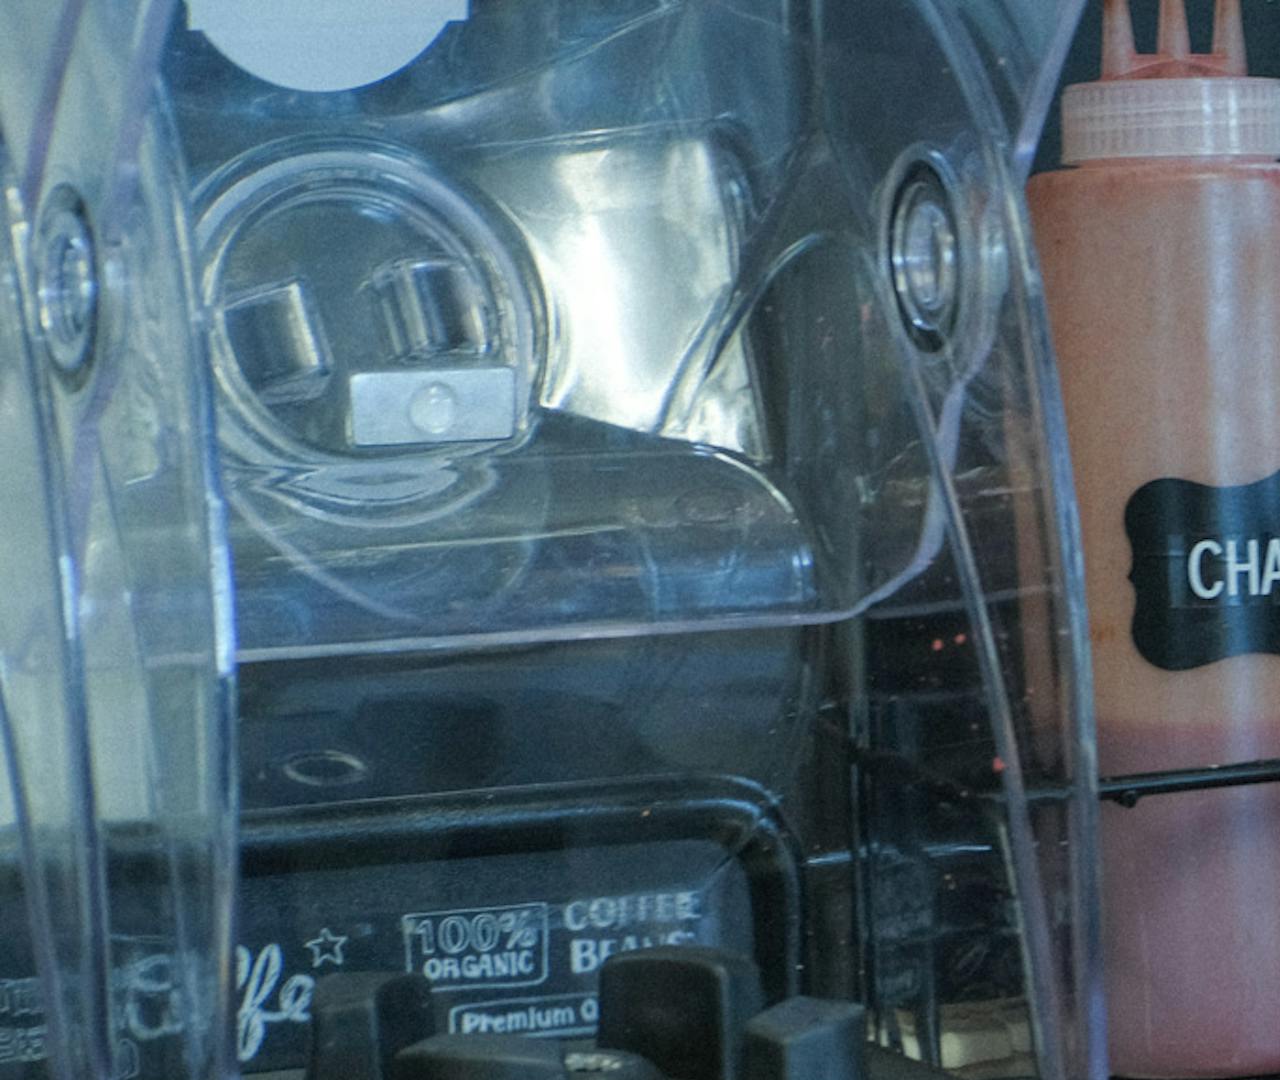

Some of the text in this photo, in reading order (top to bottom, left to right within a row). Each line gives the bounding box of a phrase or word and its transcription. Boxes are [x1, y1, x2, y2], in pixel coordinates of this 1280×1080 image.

[411, 909, 537, 955] 100%
[423, 951, 534, 981] ORGANIC
[462, 1005, 575, 1034] Premium
